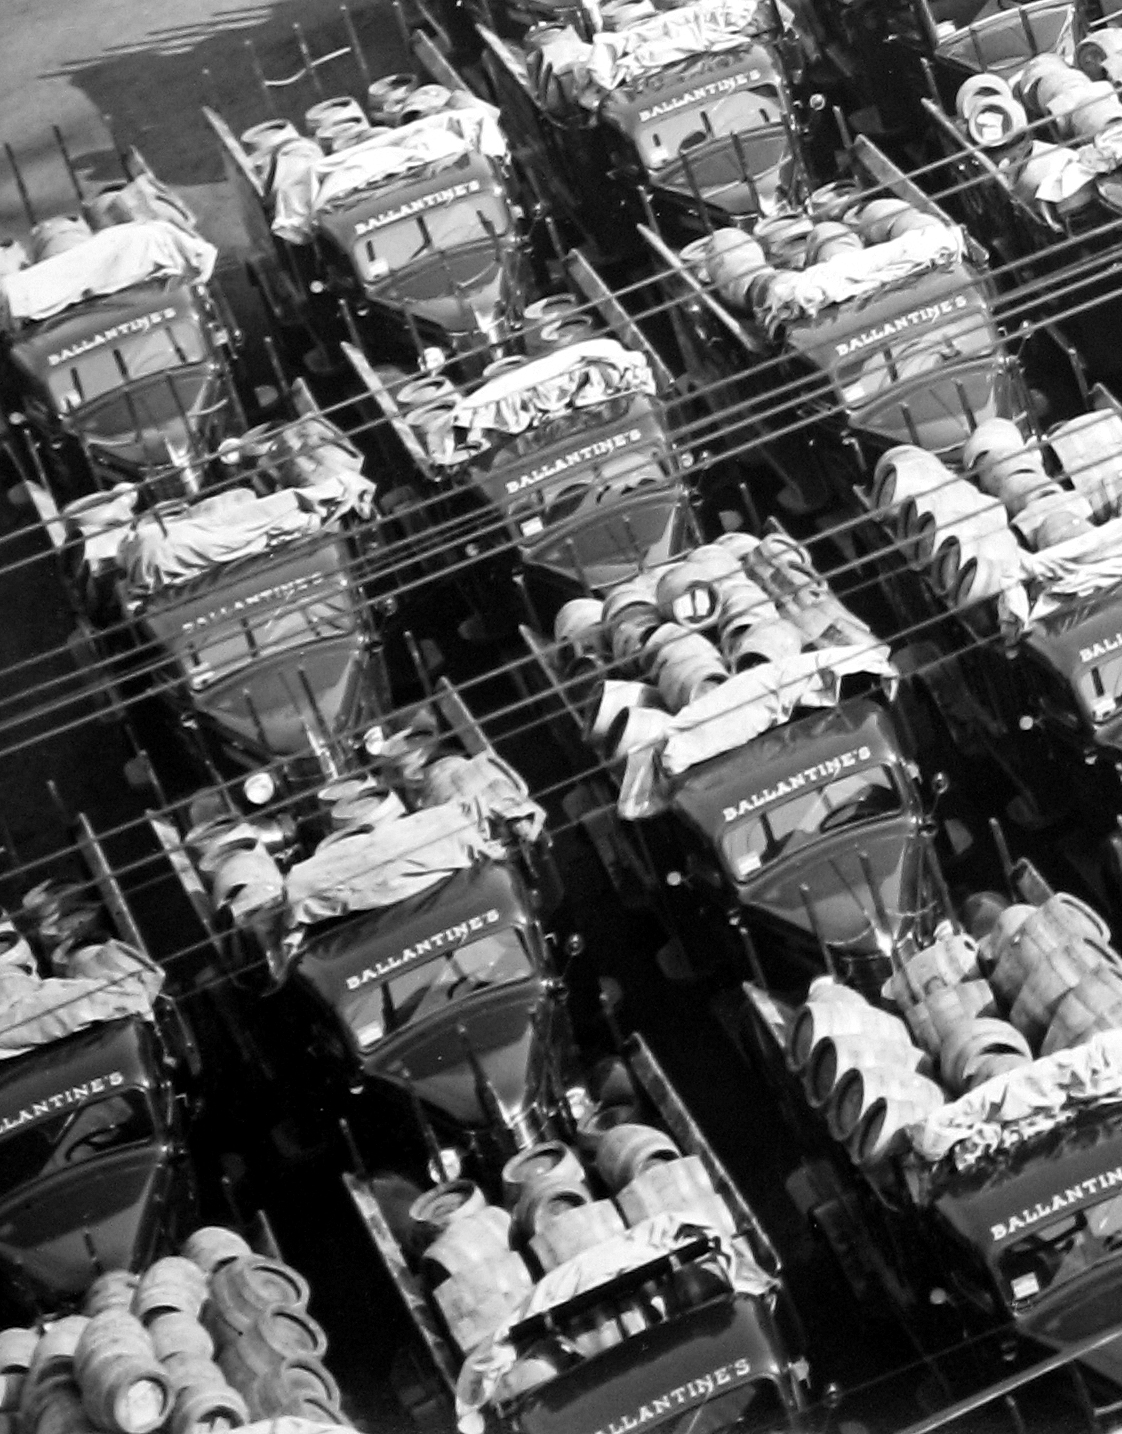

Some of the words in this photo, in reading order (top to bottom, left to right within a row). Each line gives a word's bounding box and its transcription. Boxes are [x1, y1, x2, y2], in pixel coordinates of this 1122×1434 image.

[639, 68, 762, 122] BALLANTINE'S
[353, 181, 480, 235] BALLANTINE'S
[48, 307, 177, 366] BALLANTINE'S
[834, 295, 968, 358] BALLANTINE'S
[505, 429, 642, 494] BALLANTINE'S
[721, 746, 872, 822] BALLANTINE'S
[346, 909, 500, 990] BALLANTINE'S
[0, 1072, 124, 1134] LANTINE'S
[594, 1358, 751, 1434] LLANTINE'S
